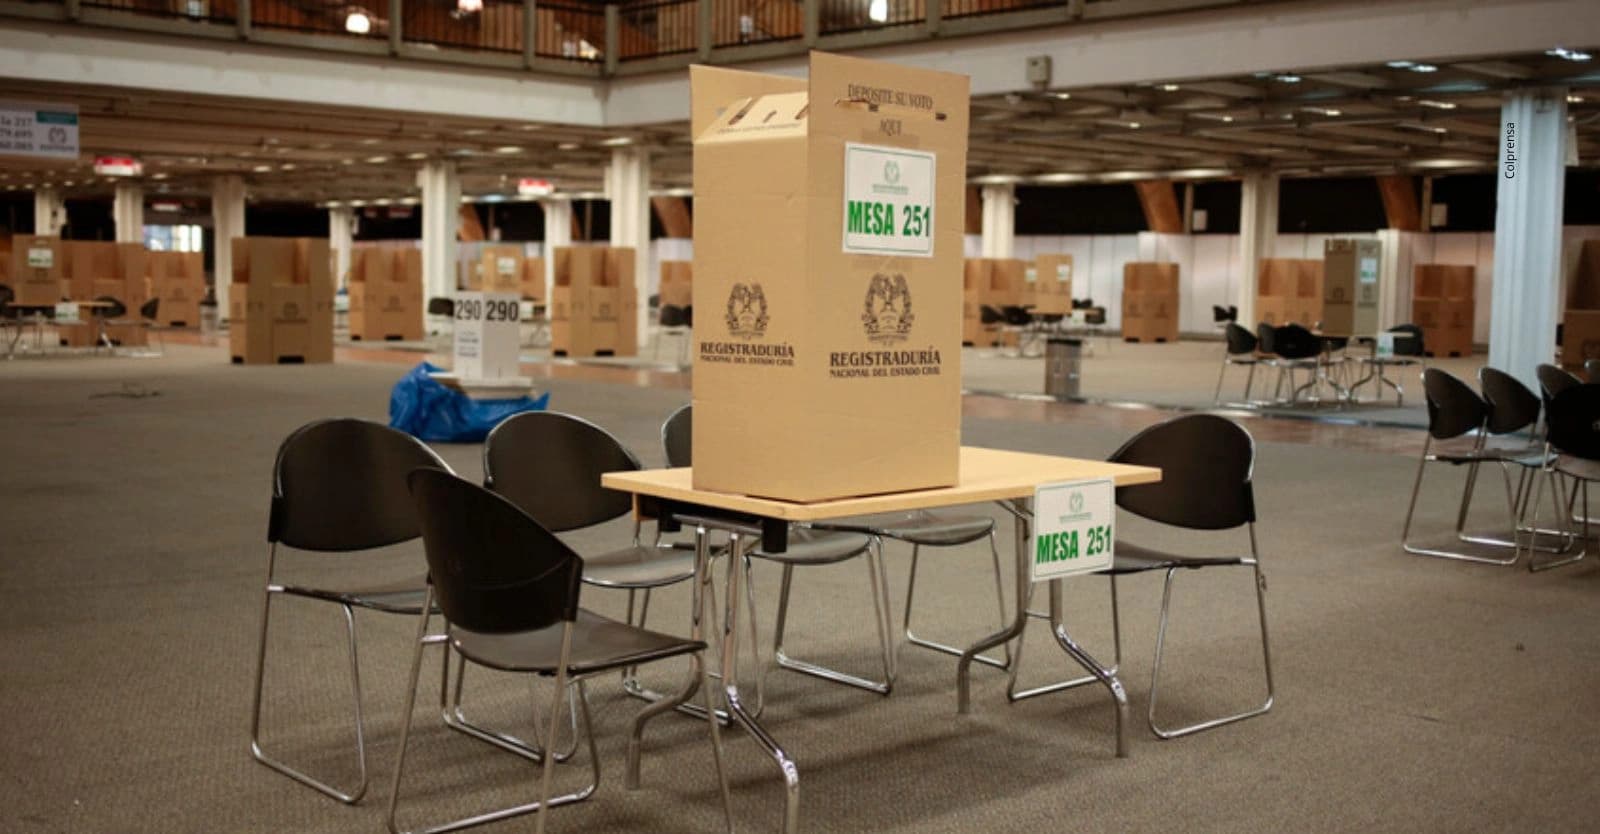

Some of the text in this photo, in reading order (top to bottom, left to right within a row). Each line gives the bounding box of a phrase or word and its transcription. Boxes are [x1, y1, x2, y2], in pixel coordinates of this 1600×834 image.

[848, 83, 933, 110] DEPOSITE SU VOTO
[848, 200, 931, 238] MESA 251
[456, 300, 481, 320] 290
[486, 300, 519, 322] 290
[700, 342, 795, 358] REGISTRADURÍA
[830, 346, 941, 366] REGISTRADURÍA
[830, 366, 940, 377] NACIONAL DEL ESTADO CIVIL
[1037, 524, 1112, 564] MESA 251
